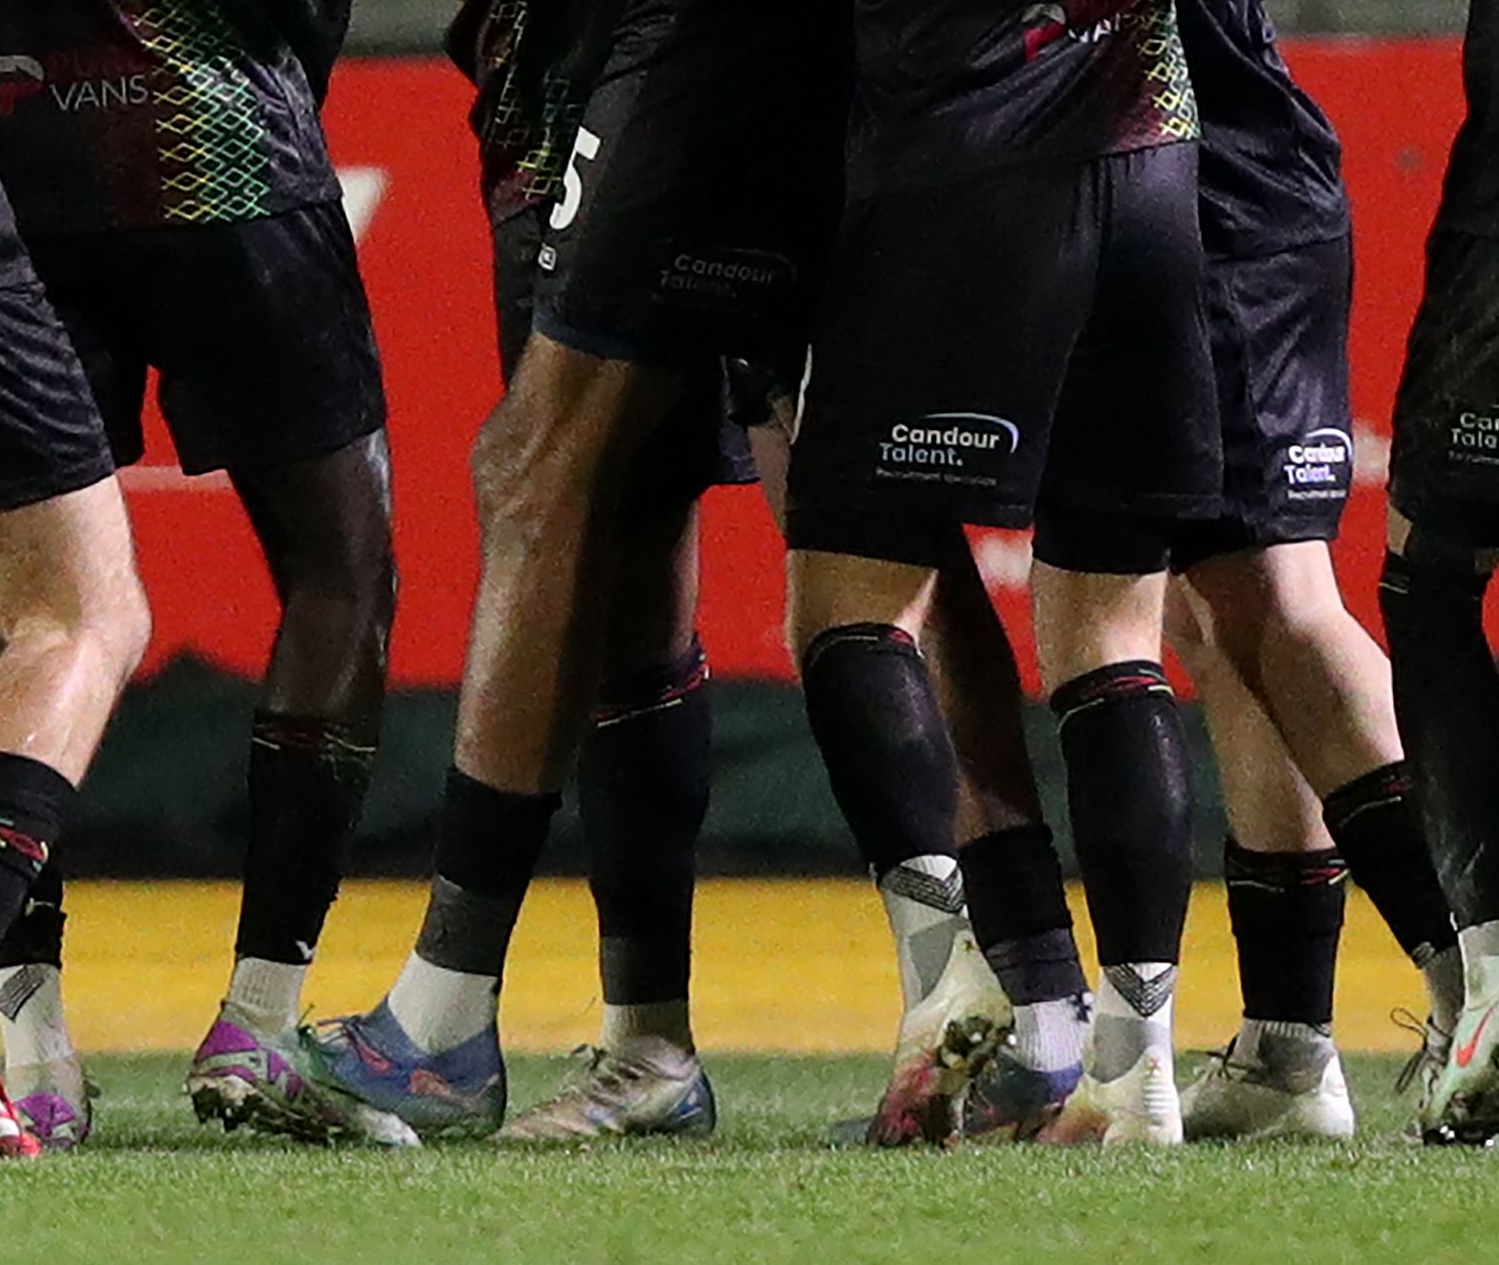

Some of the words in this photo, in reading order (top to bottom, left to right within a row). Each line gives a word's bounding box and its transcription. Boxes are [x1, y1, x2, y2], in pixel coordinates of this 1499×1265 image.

[49, 74, 150, 111] VANS
[892, 423, 1000, 449] Candour
[878, 442, 963, 466] Talent.
